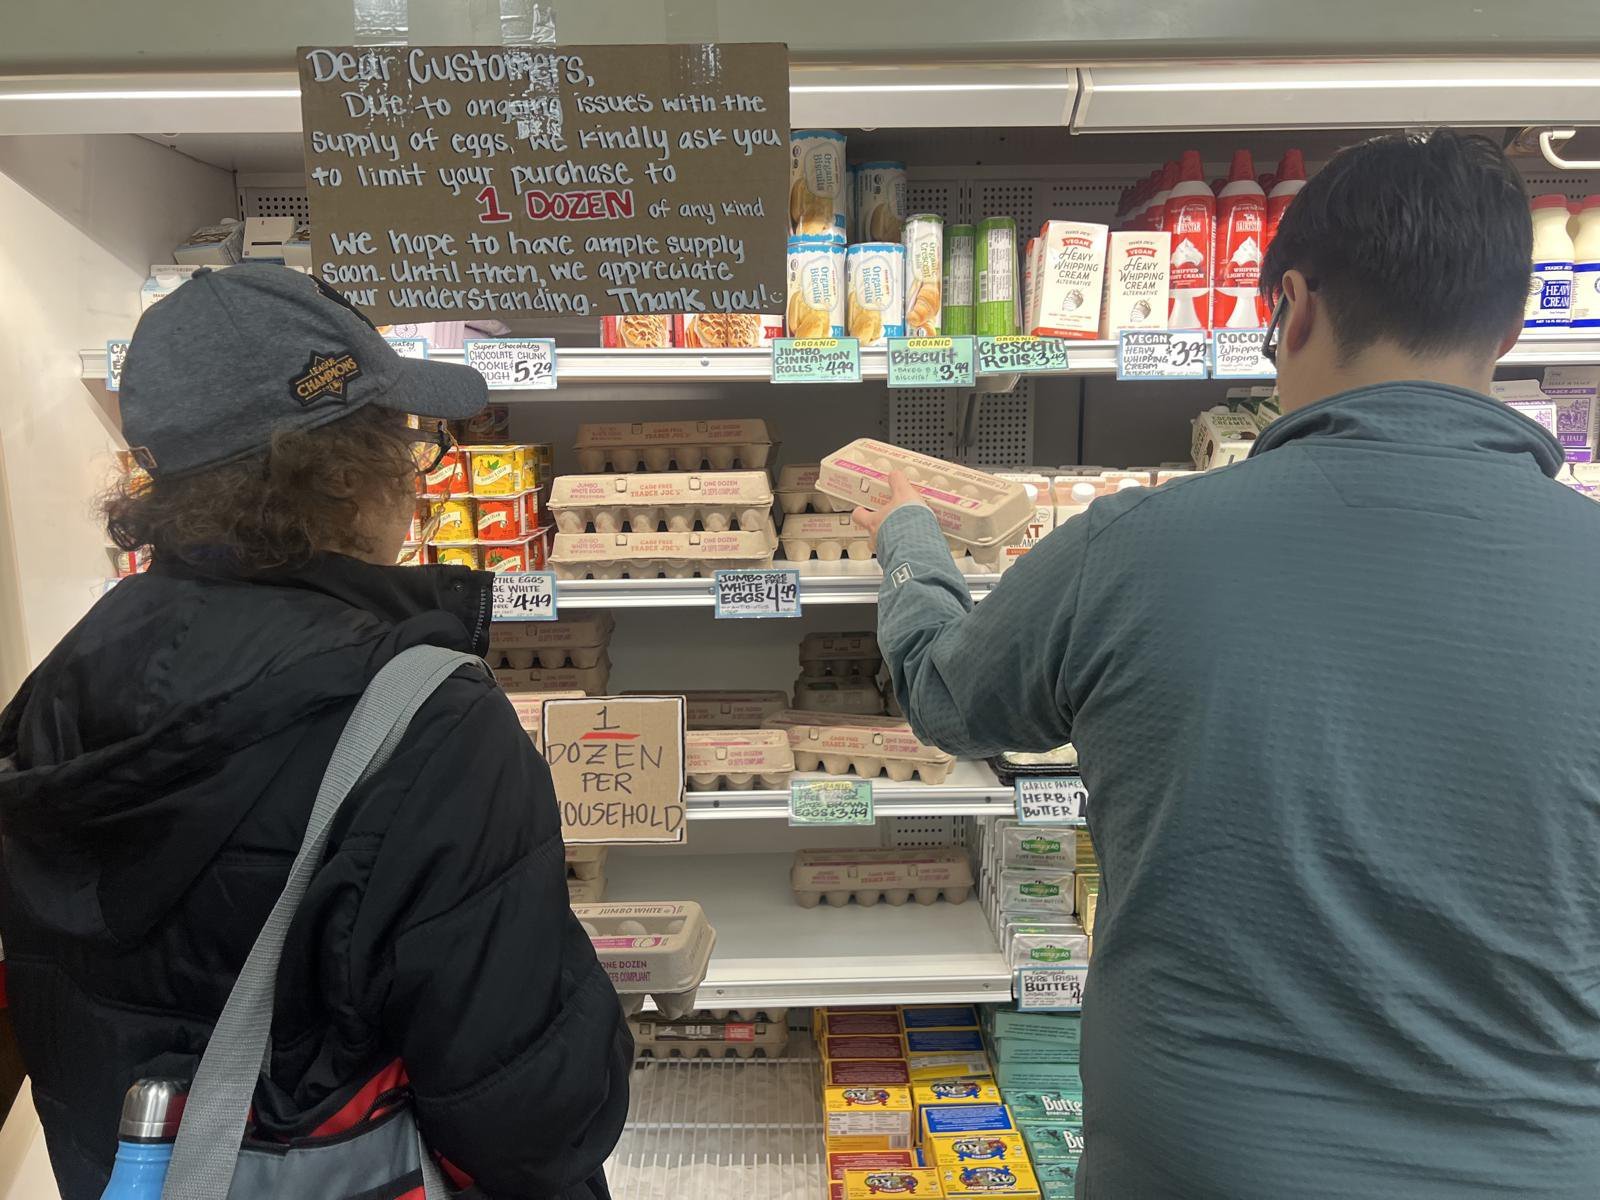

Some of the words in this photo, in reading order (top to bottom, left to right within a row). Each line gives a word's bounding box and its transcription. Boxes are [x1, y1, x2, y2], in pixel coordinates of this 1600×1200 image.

[306, 49, 396, 82] Dear
[410, 49, 595, 87] Customers,
[341, 92, 407, 118] Due
[415, 96, 450, 120] to
[575, 92, 654, 113] issues
[661, 94, 716, 112] with
[721, 94, 768, 112] the
[411, 128, 440, 151] of
[451, 133, 515, 158] eggs,
[579, 125, 670, 160] kindly
[679, 128, 727, 150] ask
[732, 129, 782, 156] you
[312, 166, 343, 187] to
[358, 163, 427, 187] limit
[439, 167, 495, 196] your
[511, 160, 635, 196] purchase
[645, 163, 677, 184] to
[476, 185, 512, 224] 1
[526, 189, 635, 221] DOZEN
[649, 198, 671, 219] of
[679, 203, 715, 224] any
[723, 197, 765, 218] kind
[389, 231, 458, 261] hope
[467, 234, 501, 256] to
[509, 232, 575, 256] have
[585, 235, 660, 257] ample
[667, 235, 745, 264] supply
[1066, 239, 1089, 247] VEGAN
[1129, 249, 1153, 257] VEGAN
[1053, 259, 1099, 272] WHIPPING
[466, 263, 545, 288] then,
[550, 261, 599, 282] we
[600, 257, 734, 287] appreciate
[1058, 270, 1090, 281] CREAM
[1118, 269, 1165, 283] WHIPPING
[1125, 281, 1156, 291] CREAM
[388, 286, 598, 316] understanding.
[607, 288, 707, 313] Thank
[711, 284, 767, 313] you!
[794, 340, 838, 348] ORGANIC
[909, 339, 951, 347] ORGANIC
[1129, 333, 1169, 345] VEGAN
[473, 342, 496, 351] Super
[776, 347, 821, 357] JUMBO
[980, 339, 1064, 355] Crescent
[1125, 346, 1156, 356] HEAVY
[469, 350, 514, 362] CHOCOLATE
[517, 351, 547, 361] CHUNK
[775, 350, 851, 365] CINNAMON
[891, 347, 957, 366] Biscuit
[980, 353, 1031, 369] Rolls
[1123, 355, 1169, 365] WHIPPING
[309, 357, 337, 376] LEAGUE
[776, 364, 813, 374] ROLLS
[296, 357, 358, 397] CHAMPIONS
[518, 576, 544, 584] EGGS
[720, 574, 763, 583] JUMBO
[508, 585, 541, 593] WHITE
[721, 592, 766, 605] EGGS
[592, 706, 621, 731] 1
[547, 742, 663, 771] DOZEN
[581, 771, 633, 795] PER
[1022, 792, 1066, 804] HERB
[795, 808, 829, 818] EGGS
[619, 961, 648, 969] DOZEN
[620, 971, 651, 983] COMPLIANT
[1025, 982, 1081, 992] BUTTER
[1041, 1095, 1084, 1112] Butte
